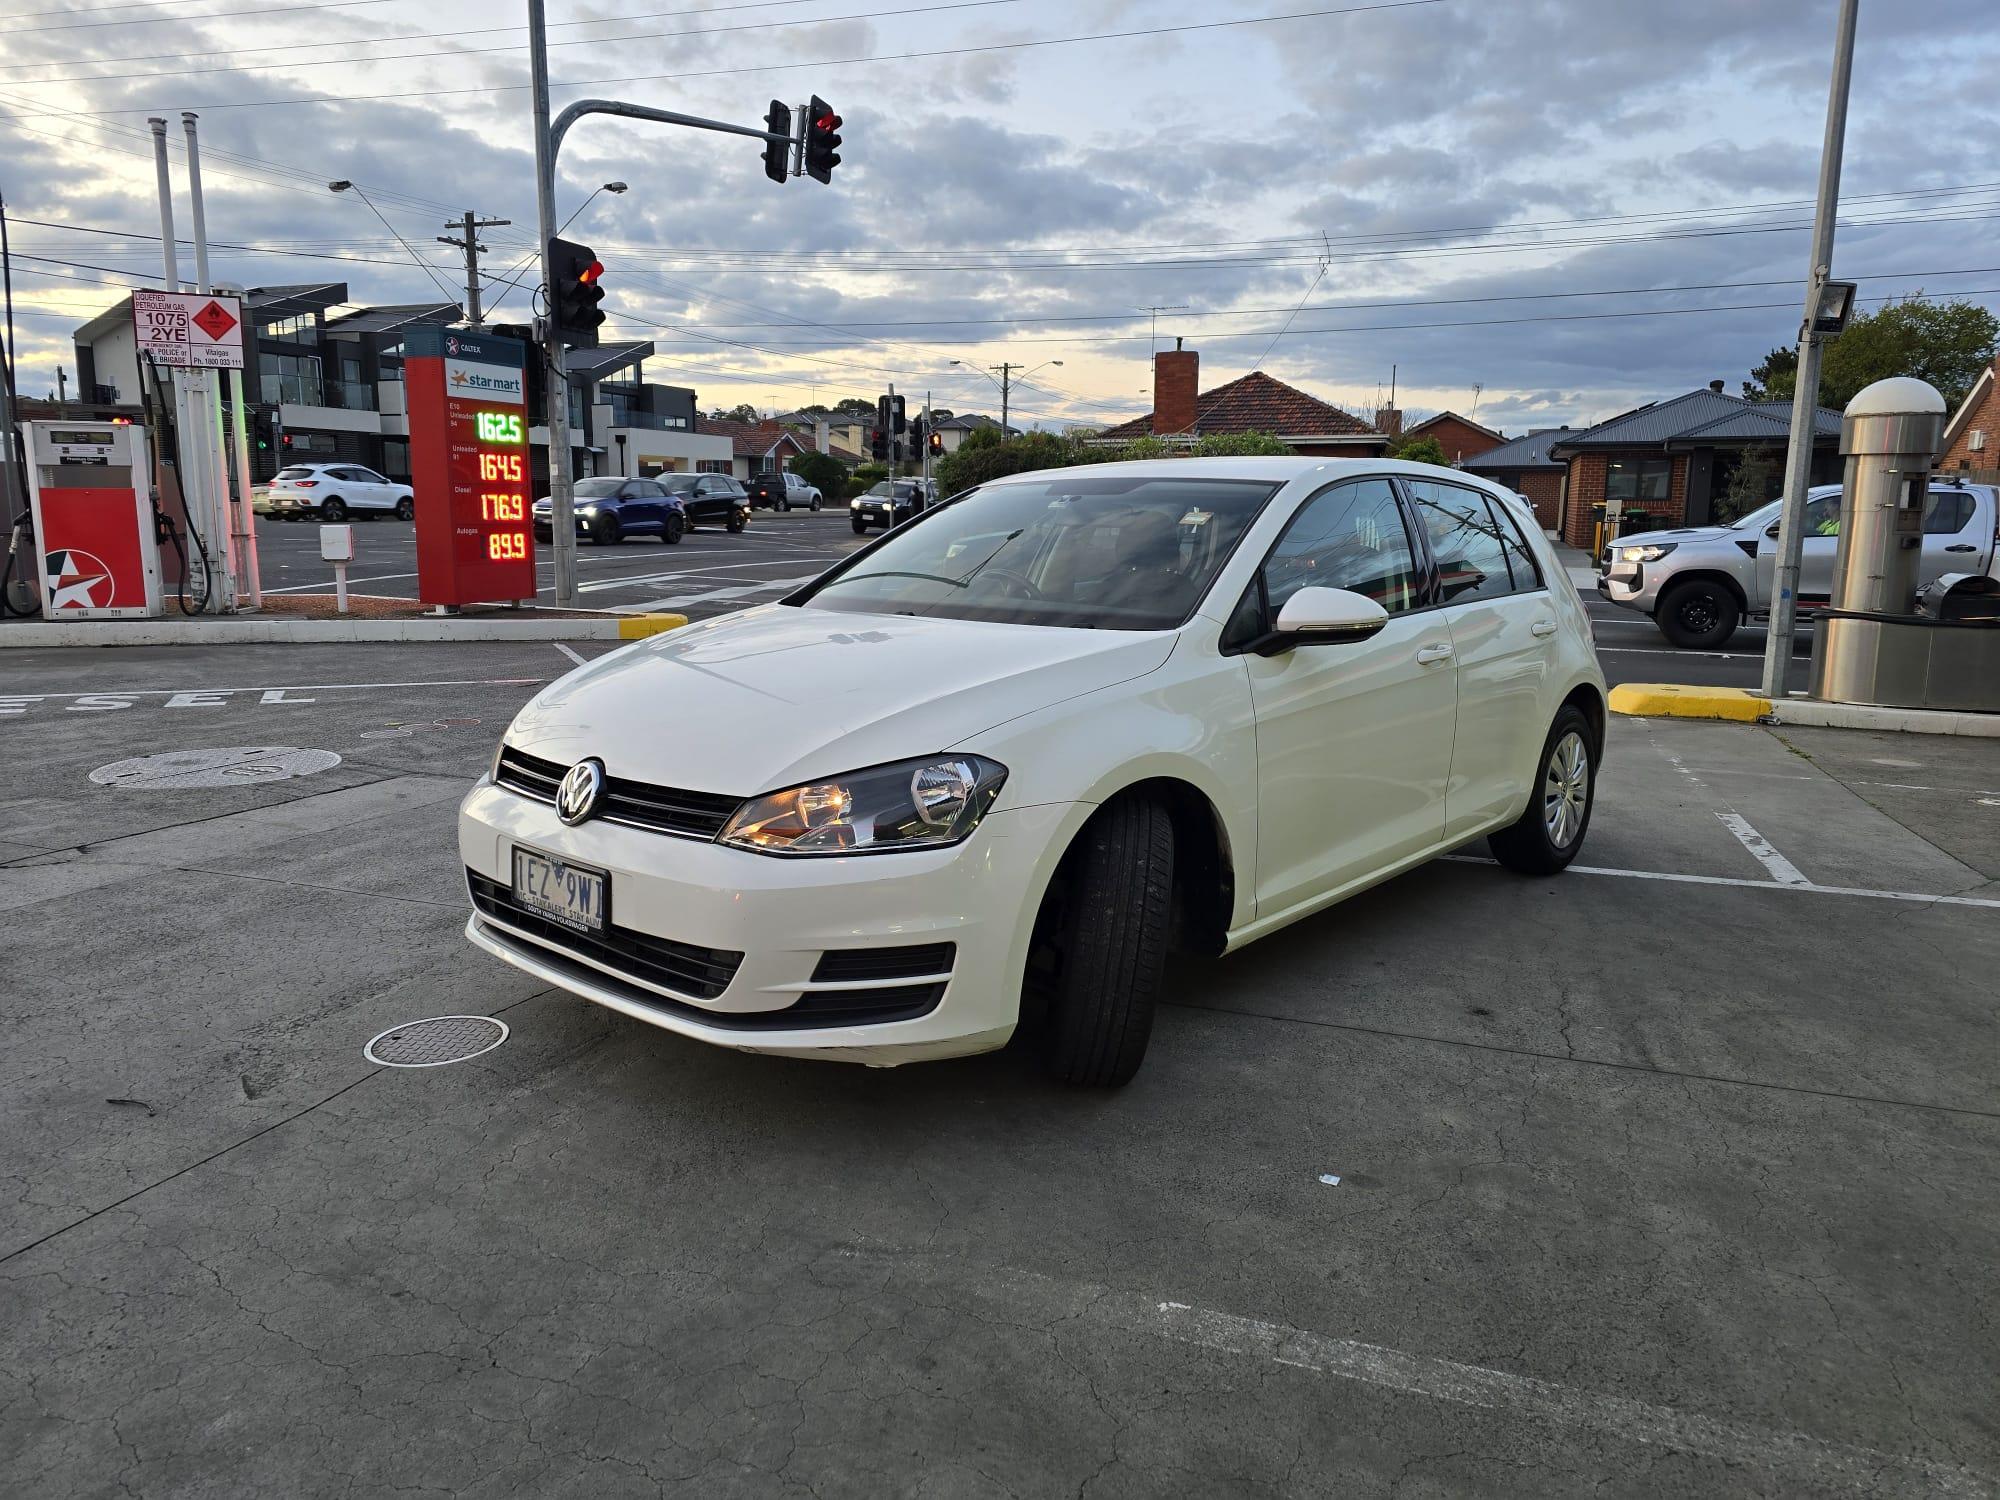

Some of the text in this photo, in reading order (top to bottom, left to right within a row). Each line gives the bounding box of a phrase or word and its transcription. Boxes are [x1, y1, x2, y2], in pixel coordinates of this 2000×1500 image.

[135, 294, 166, 302] LIQUEFIED
[135, 301, 185, 311] PETROLEUM GAS
[146, 312, 187, 327] 1075
[151, 327, 187, 342] 2YE
[158, 348, 179, 356] POLICE
[205, 348, 229, 358] Vitalgas
[461, 344, 481, 354] CALTEX
[159, 356, 186, 364] BRIGADE
[469, 374, 520, 391] star mart
[450, 411, 521, 443] Unleaded 162.5
[452, 445, 478, 453] Unleaded
[479, 453, 521, 481] 164.5
[480, 494, 524, 521] 176.9
[456, 528, 525, 560] Autogas 89.9
[557, 915, 589, 933] VOLKSWAGEN
